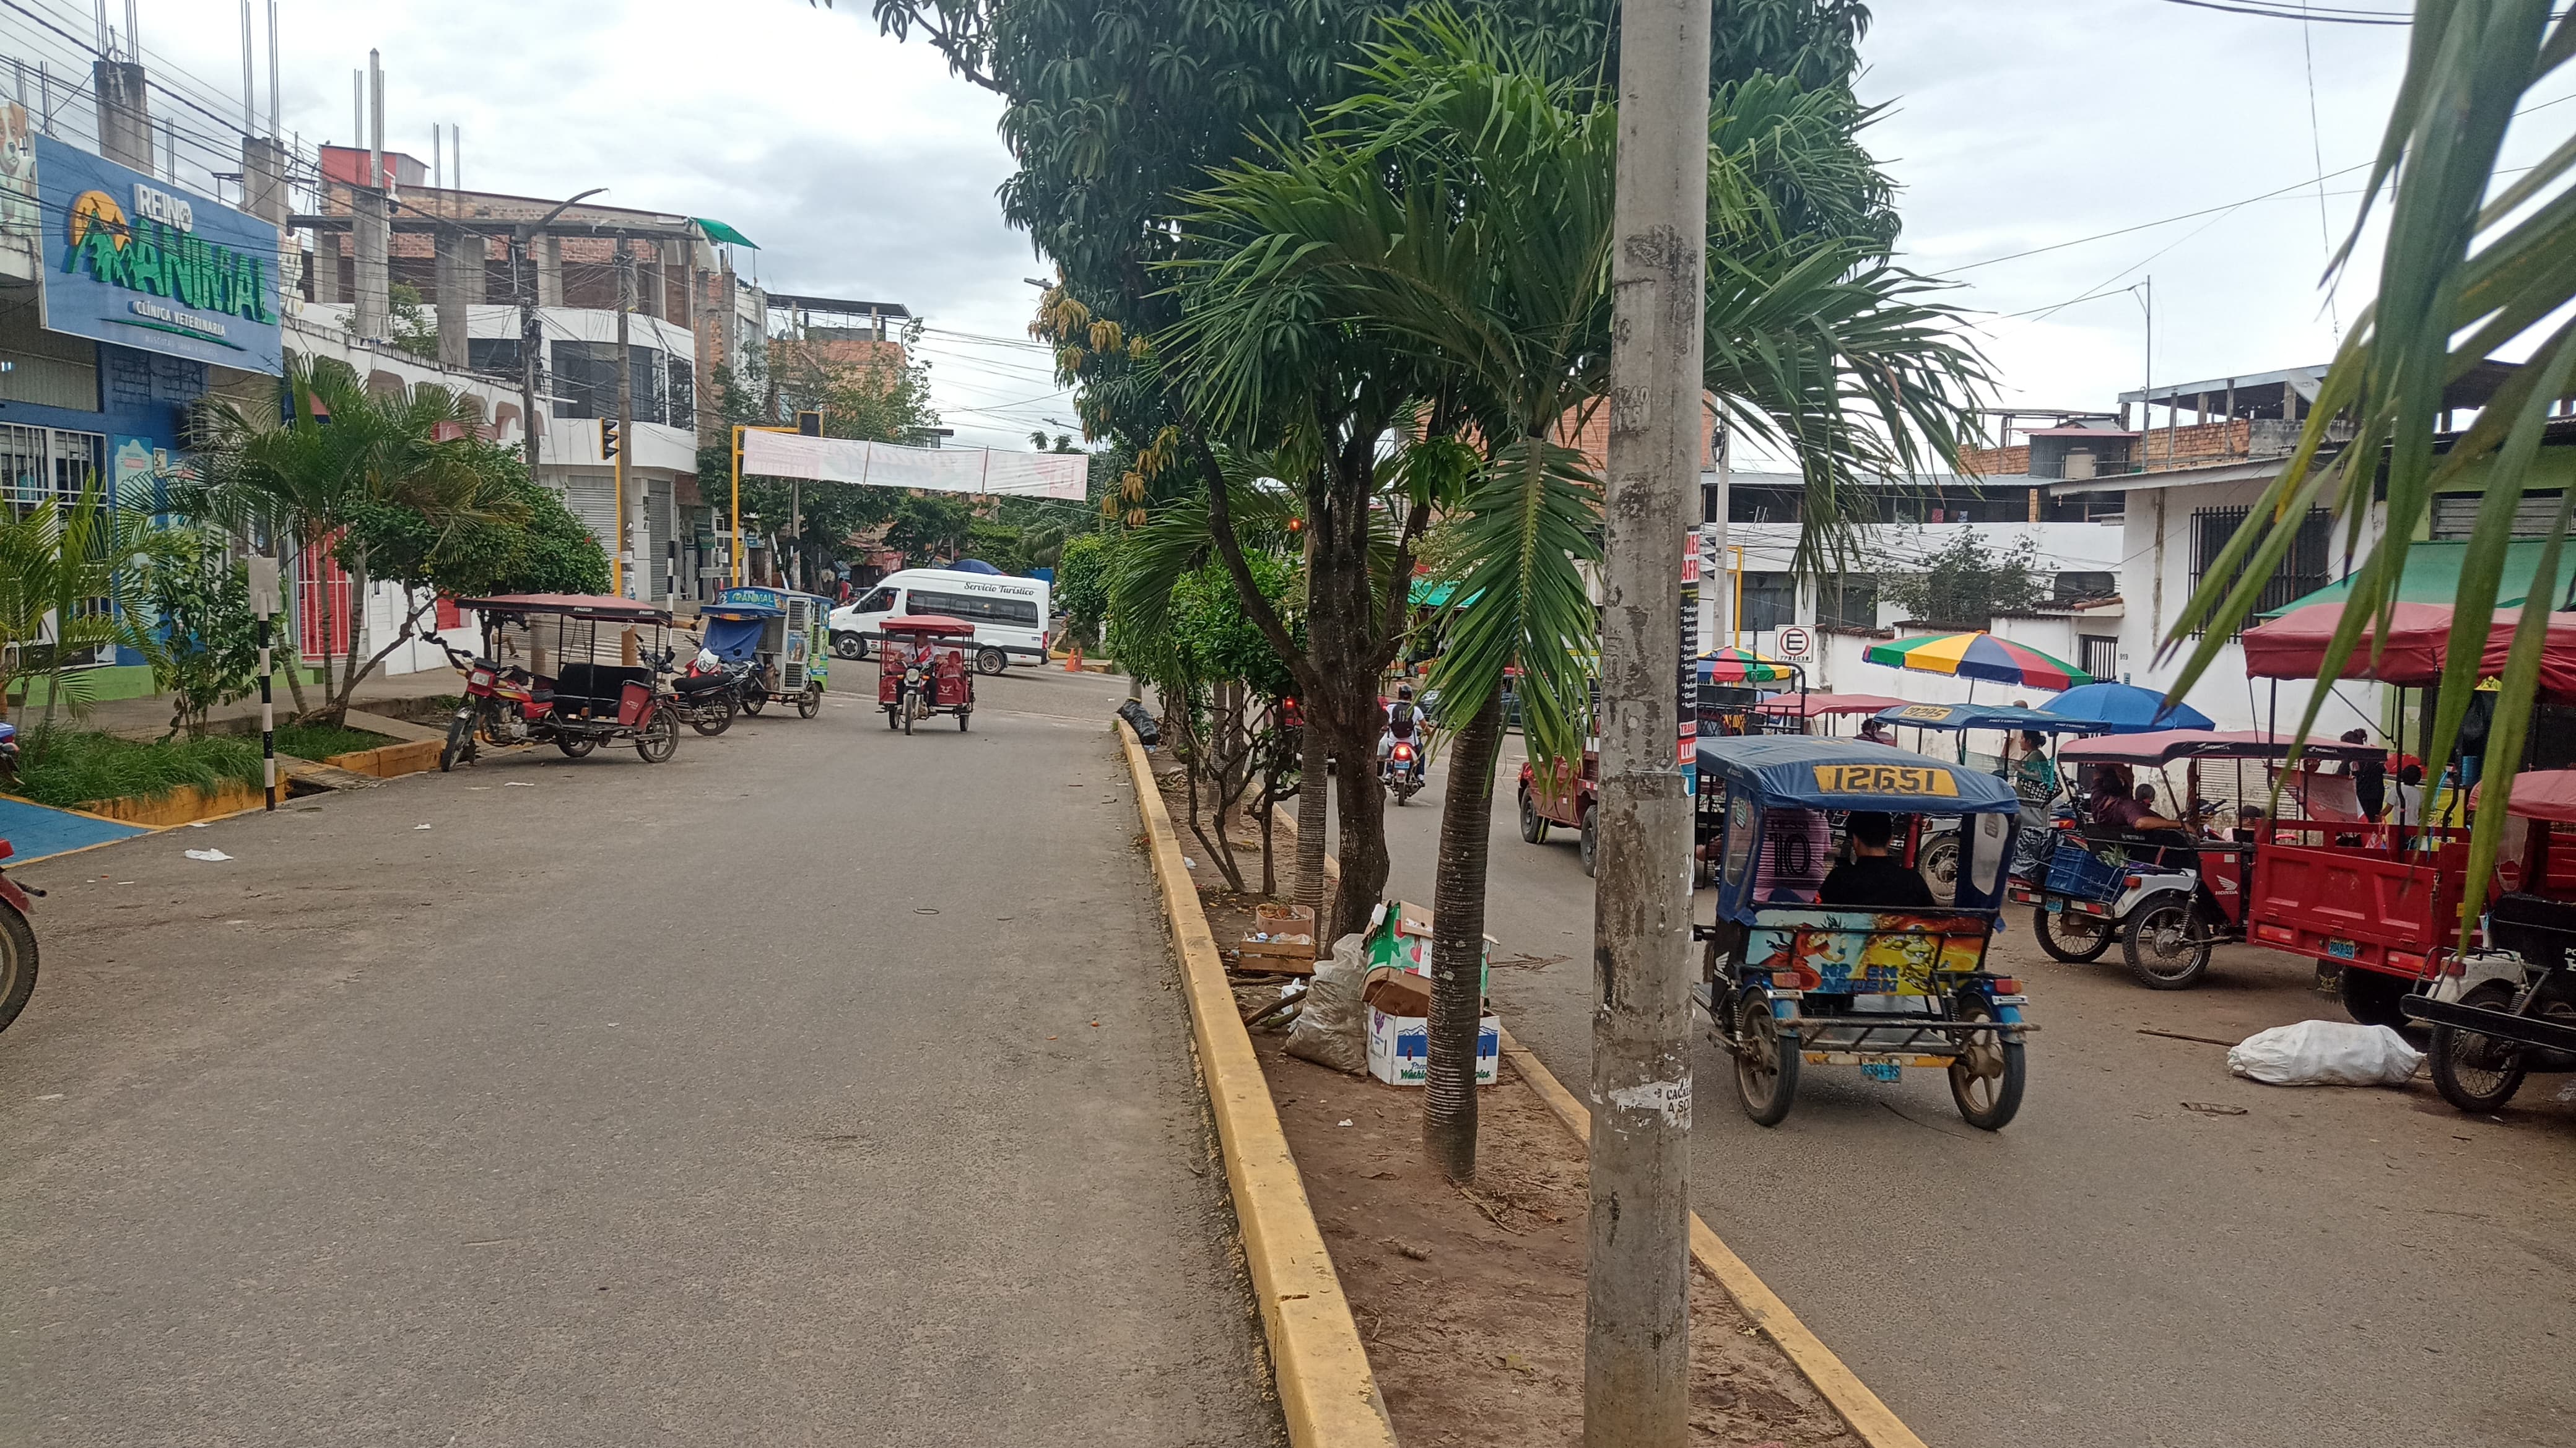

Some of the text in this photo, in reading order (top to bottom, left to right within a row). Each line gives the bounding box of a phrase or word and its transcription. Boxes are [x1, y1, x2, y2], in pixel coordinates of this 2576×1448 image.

[134, 183, 193, 233] REINO
[135, 218, 277, 326] ANIMAL
[173, 311, 226, 336] VETERINARIA
[964, 581, 997, 592] Servicio
[1786, 633, 1803, 650] E
[1834, 767, 1934, 791] 12651
